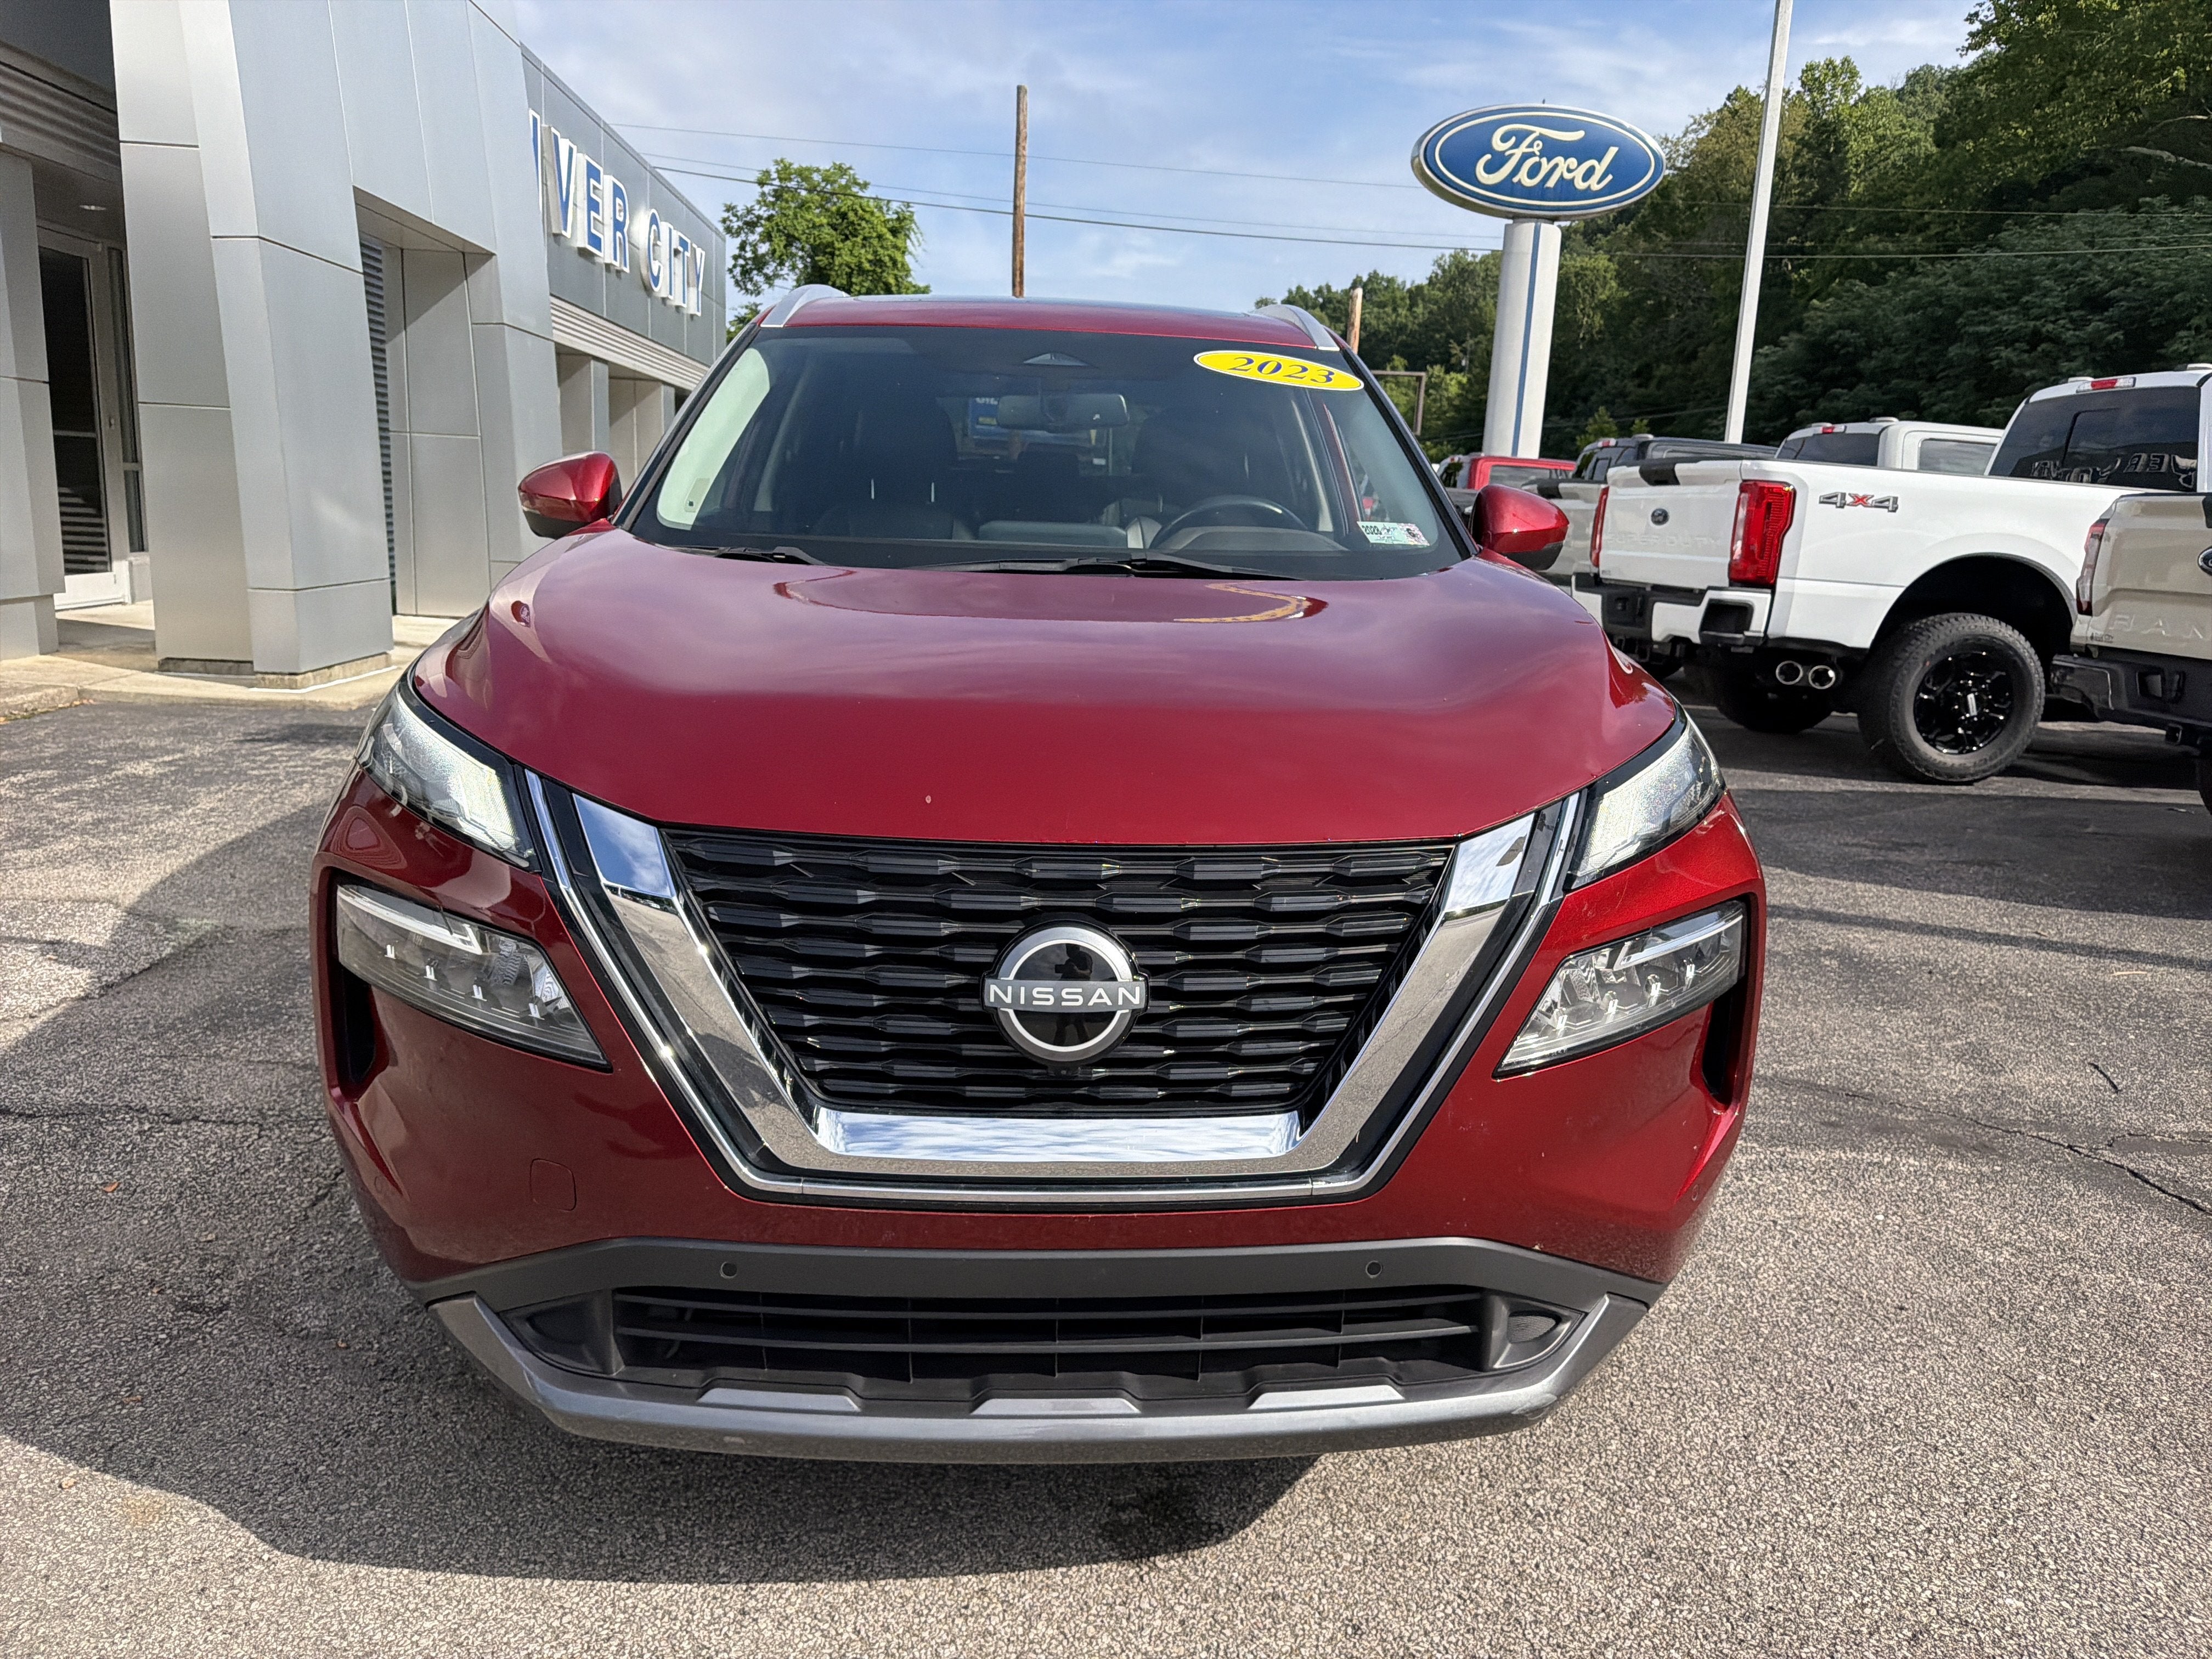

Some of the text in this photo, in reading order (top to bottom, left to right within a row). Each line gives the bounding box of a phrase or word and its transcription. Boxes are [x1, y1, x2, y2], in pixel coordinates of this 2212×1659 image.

[1475, 123, 1619, 191] Ford
[645, 208, 706, 317] CITY
[1227, 357, 1335, 383] 2023
[989, 984, 1140, 1006] NISSAN
